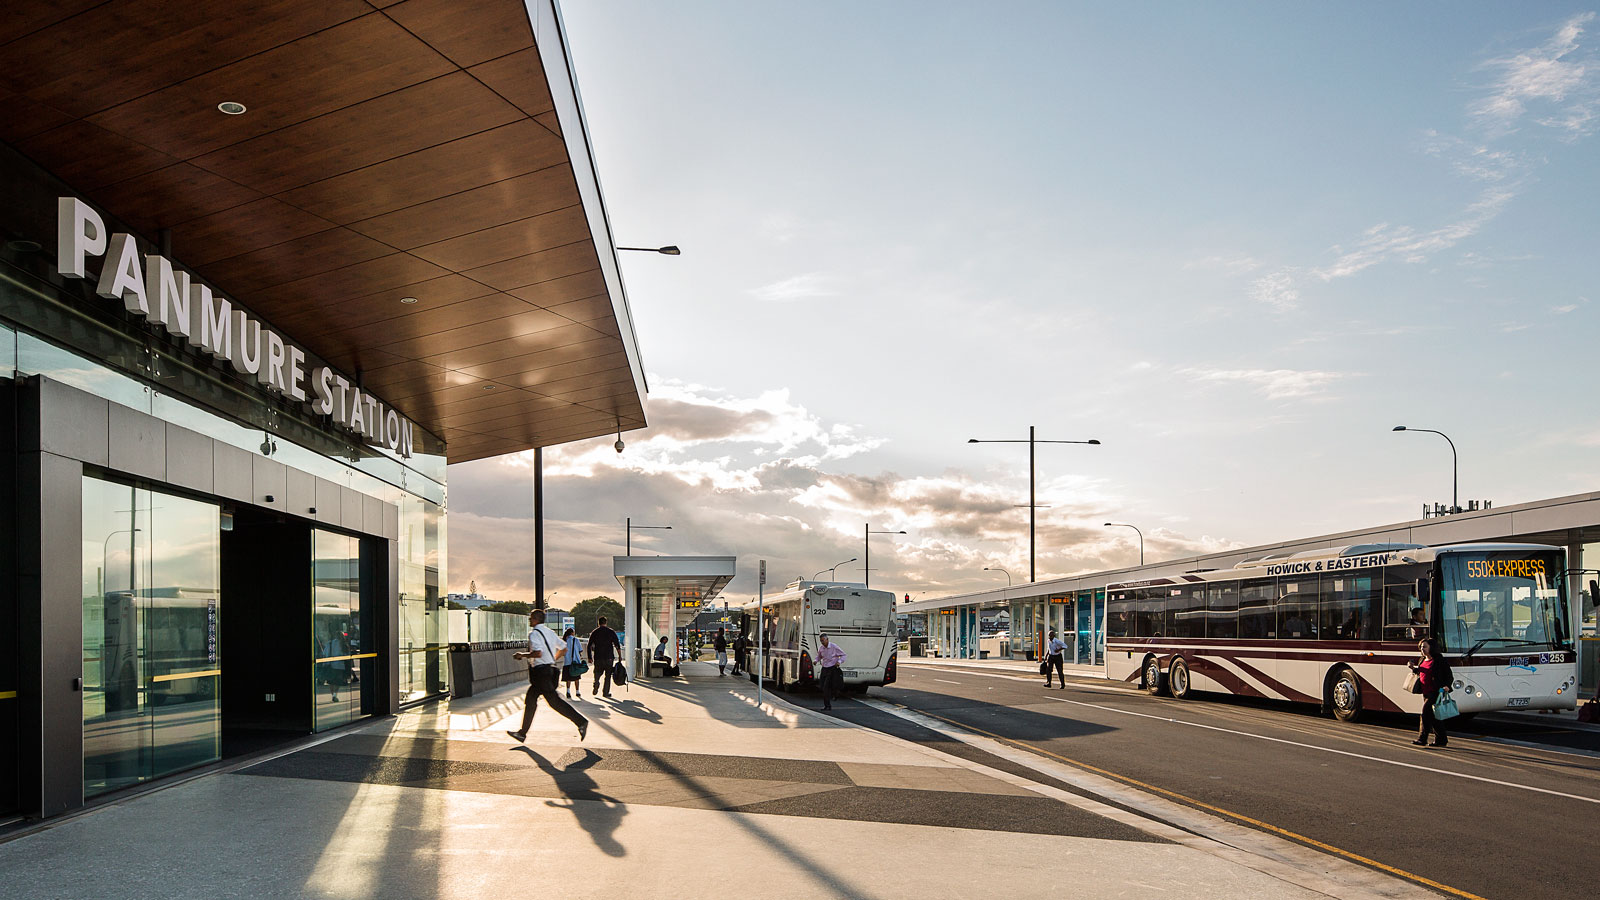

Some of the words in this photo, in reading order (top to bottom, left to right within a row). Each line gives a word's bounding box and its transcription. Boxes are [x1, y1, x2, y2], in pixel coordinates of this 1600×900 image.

[57, 196, 306, 402] PANMURE
[312, 366, 413, 459] STATION
[1266, 562, 1312, 576] HOWICK
[1315, 561, 1323, 571] &
[1327, 554, 1390, 570] EASTERN
[1467, 560, 1496, 578] 550X
[1497, 559, 1546, 577] EXPRESS
[813, 608, 827, 616] 220
[1549, 653, 1565, 663] 253
